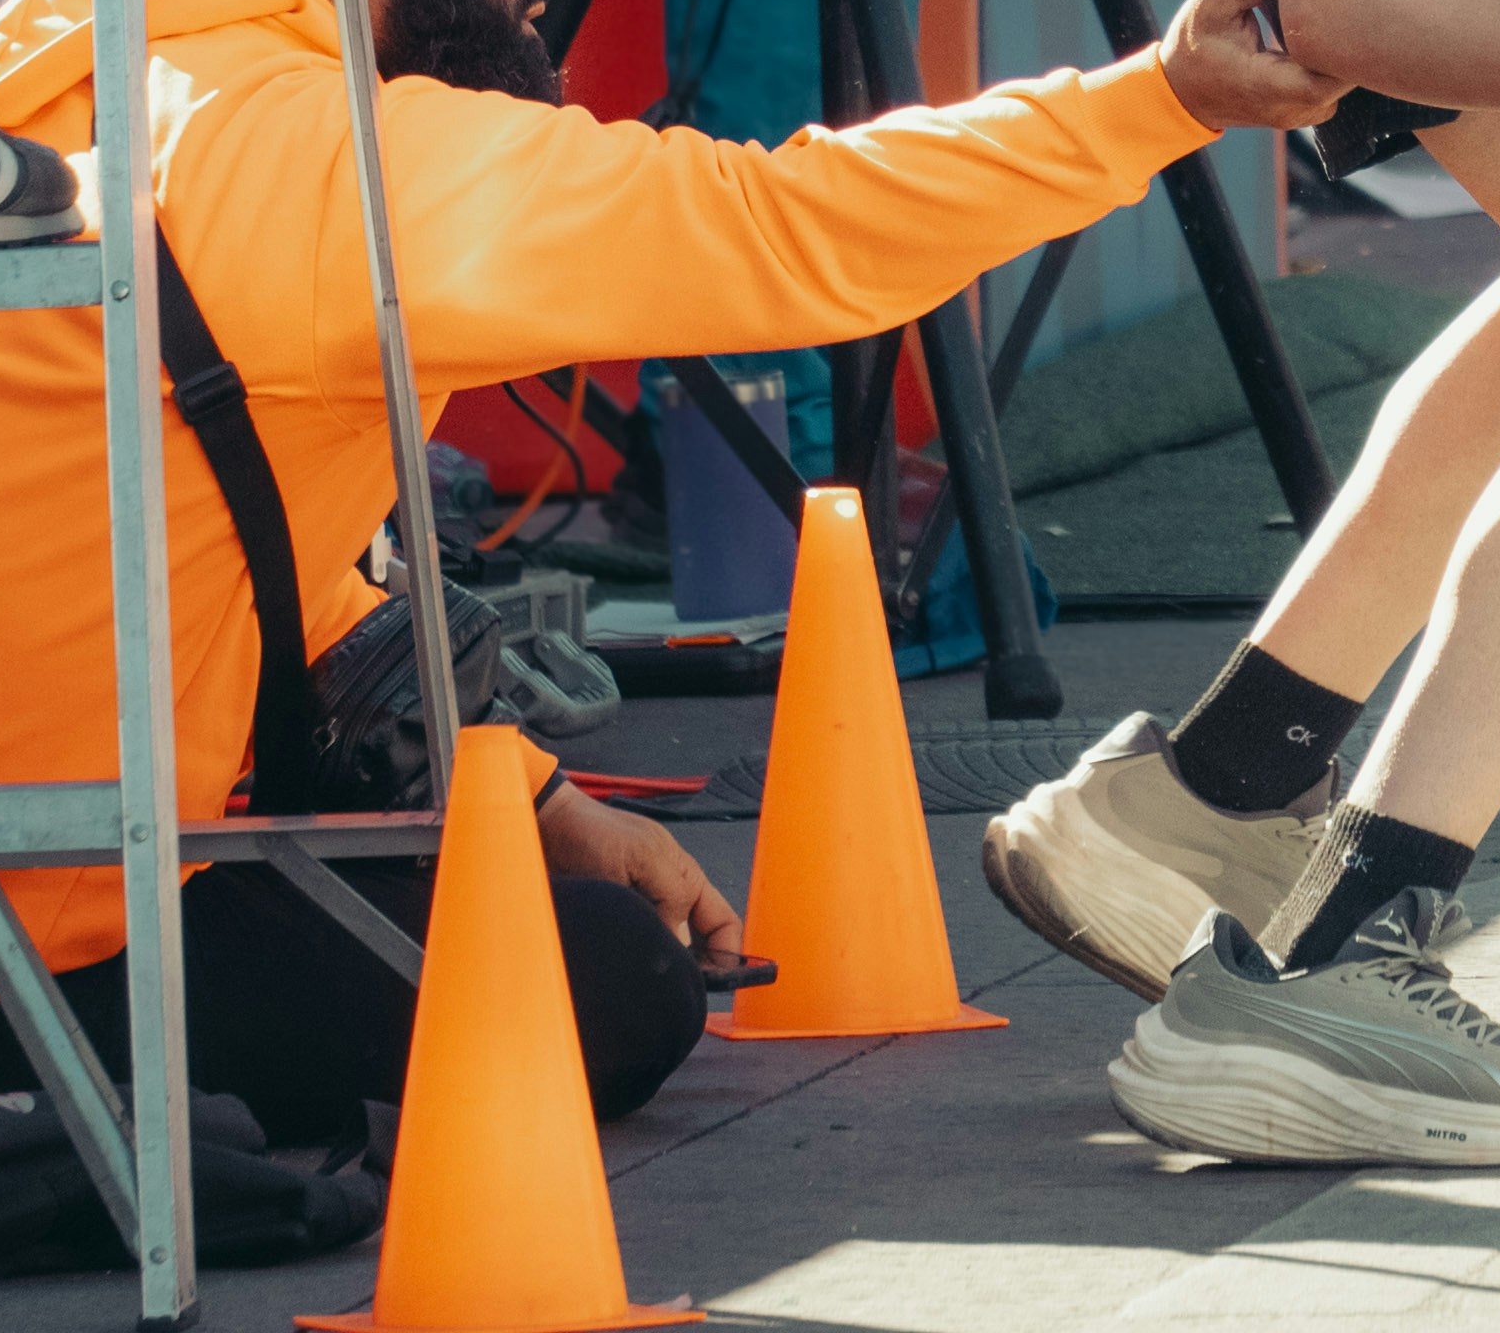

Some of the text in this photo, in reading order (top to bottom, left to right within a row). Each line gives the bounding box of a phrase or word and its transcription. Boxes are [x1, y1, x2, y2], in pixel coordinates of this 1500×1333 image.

[1286, 724, 1320, 748] CK
[1341, 848, 1374, 874] CK
[1426, 1127, 1468, 1142] NITRO
